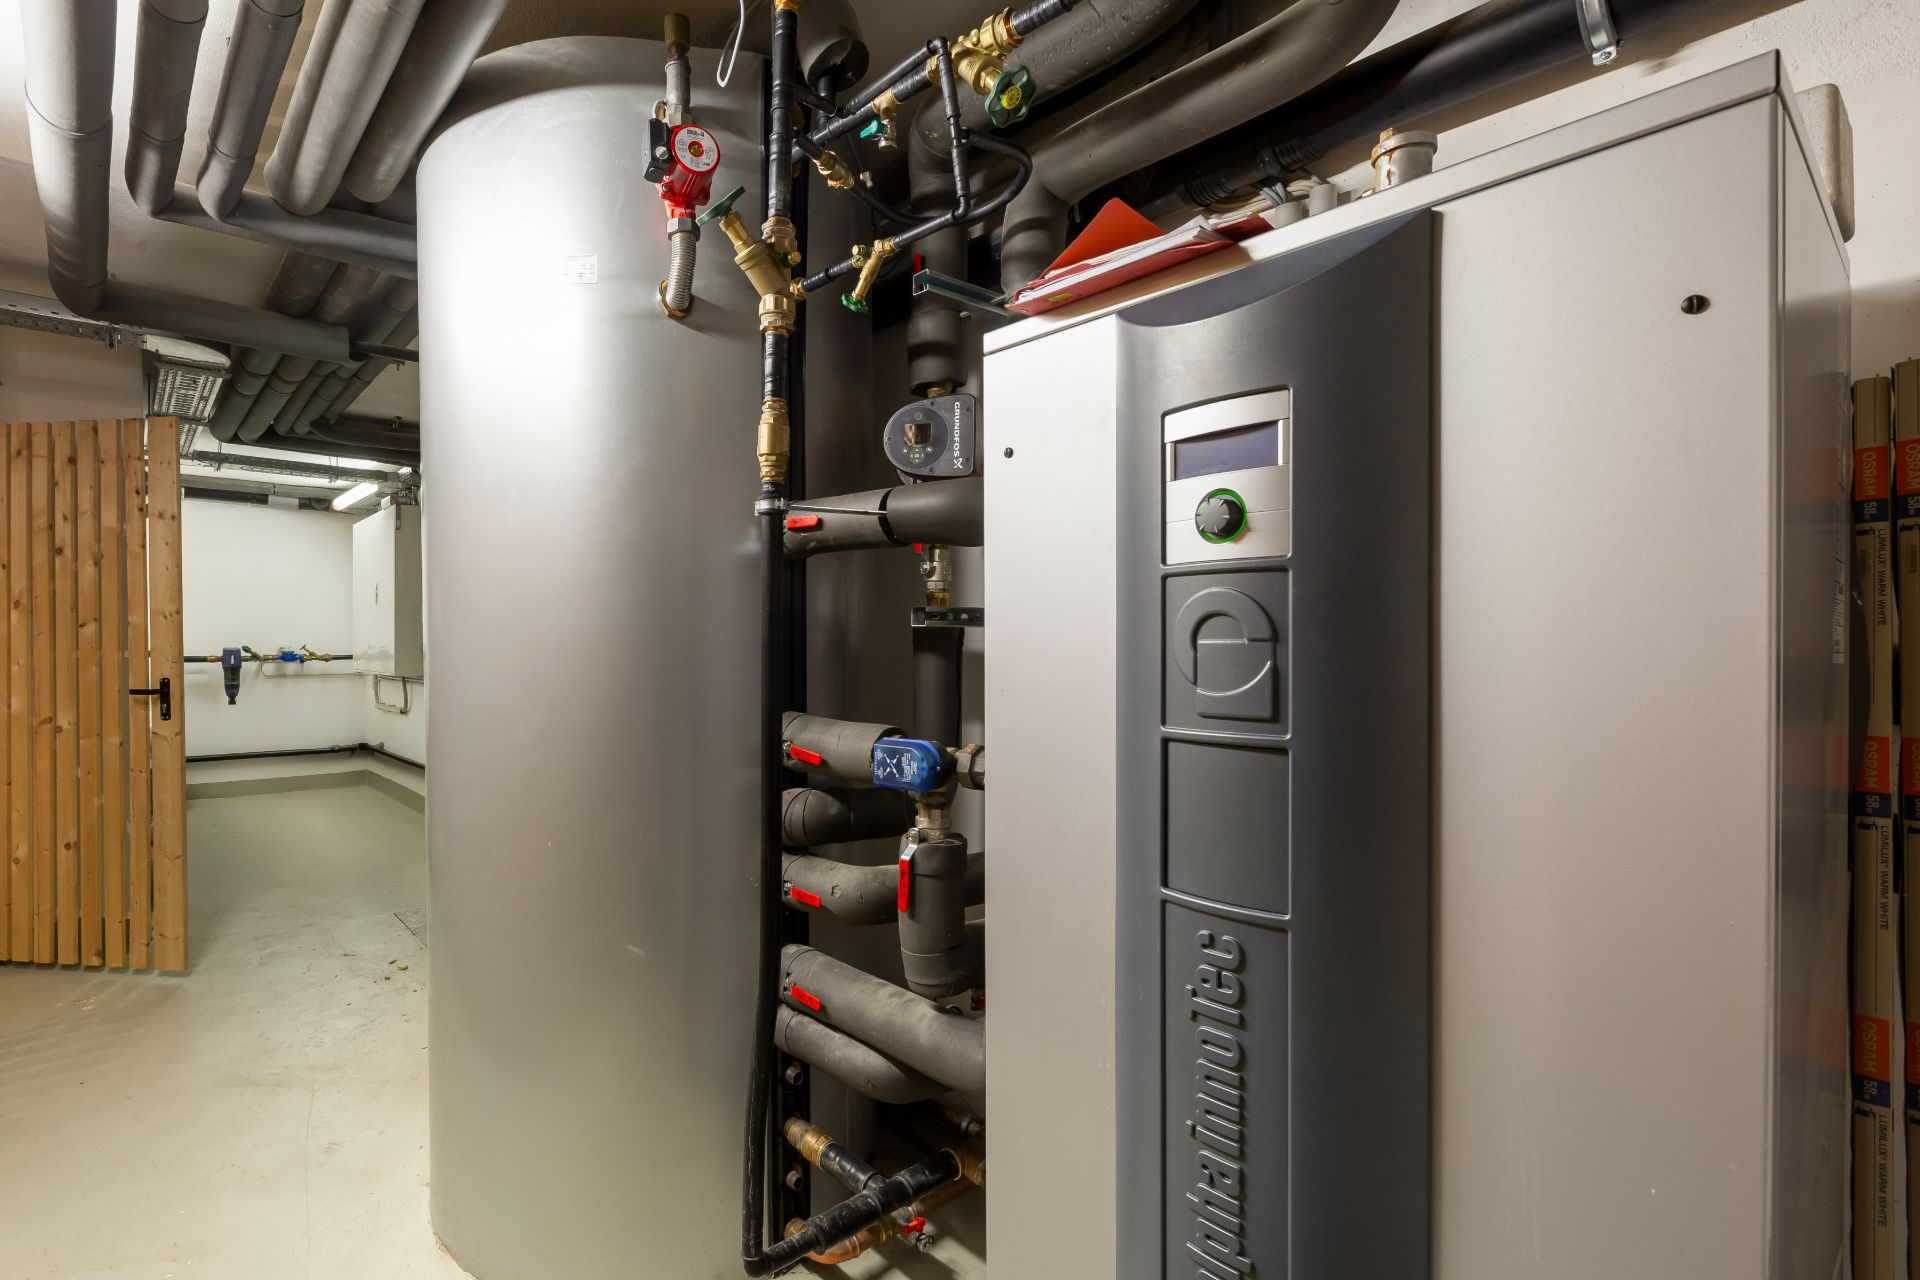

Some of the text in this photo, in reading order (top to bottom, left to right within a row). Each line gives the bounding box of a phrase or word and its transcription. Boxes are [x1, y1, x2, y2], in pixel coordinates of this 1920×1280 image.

[1861, 451, 1877, 496] OSRAM
[1904, 443, 1920, 490] OSRAM
[1878, 570, 1886, 597] WARM
[1878, 599, 1886, 625] WHITE
[1863, 741, 1878, 788] OSRAM
[1880, 870, 1889, 899] WARM
[1880, 901, 1889, 930] WHITE
[1861, 1021, 1877, 1073] OSRAM
[1879, 1162, 1888, 1193] WARM
[1879, 1196, 1888, 1228] WHITE
